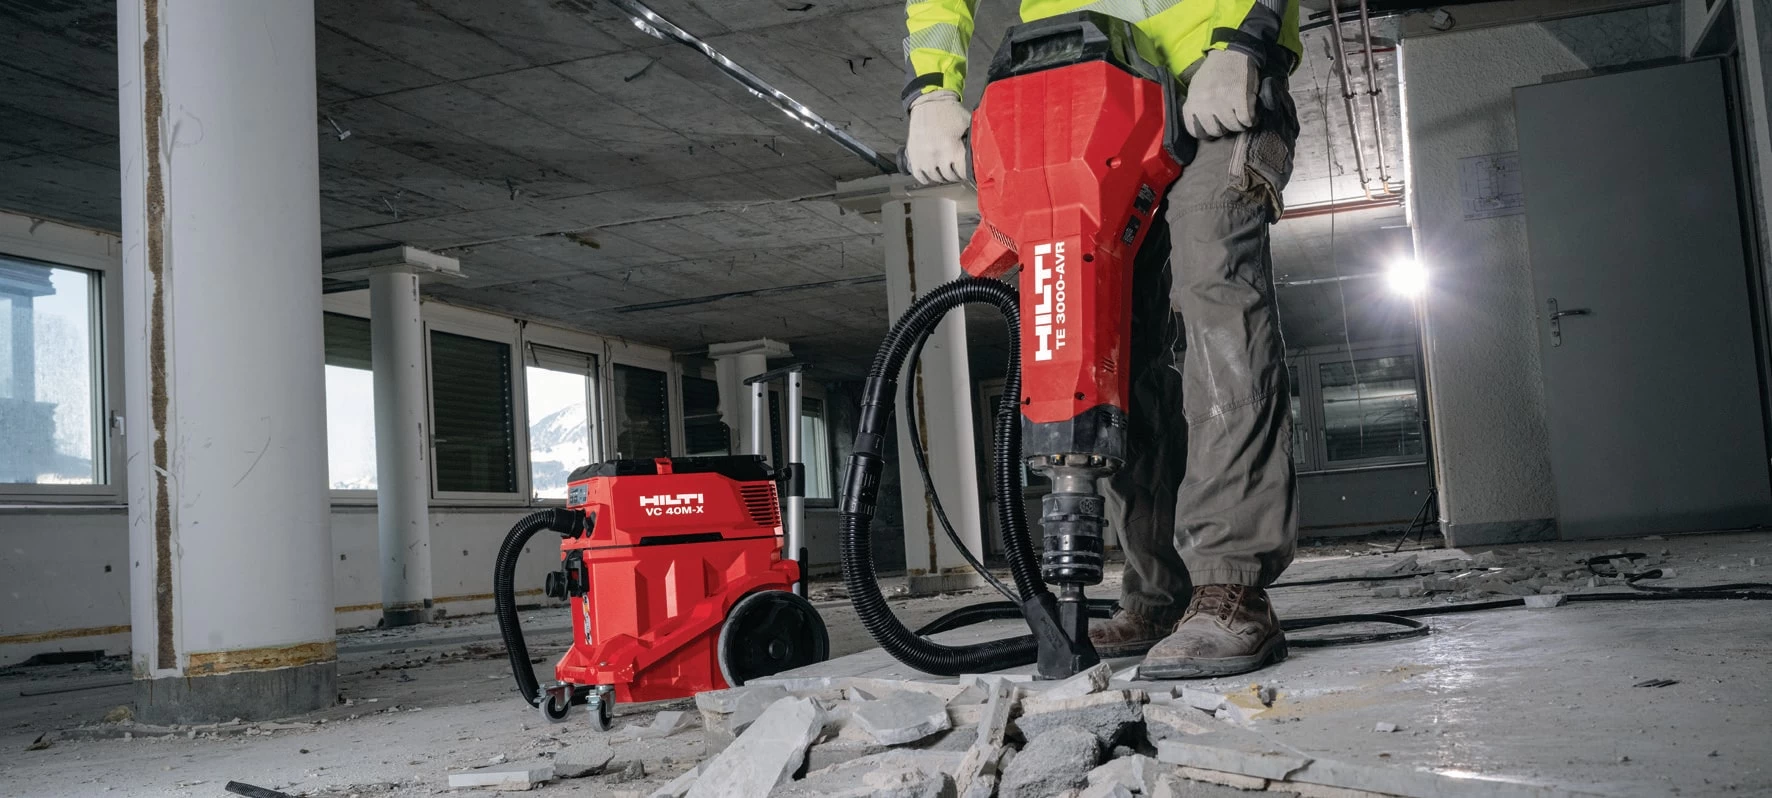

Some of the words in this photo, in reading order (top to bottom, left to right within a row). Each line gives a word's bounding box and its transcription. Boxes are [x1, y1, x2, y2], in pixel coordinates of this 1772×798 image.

[1055, 241, 1066, 323] 3000-AVR
[1034, 242, 1053, 362] HILTI
[1055, 327, 1066, 350] TE
[639, 493, 704, 506] HILTI
[645, 507, 663, 517] VC
[665, 505, 704, 516] 40M-X
